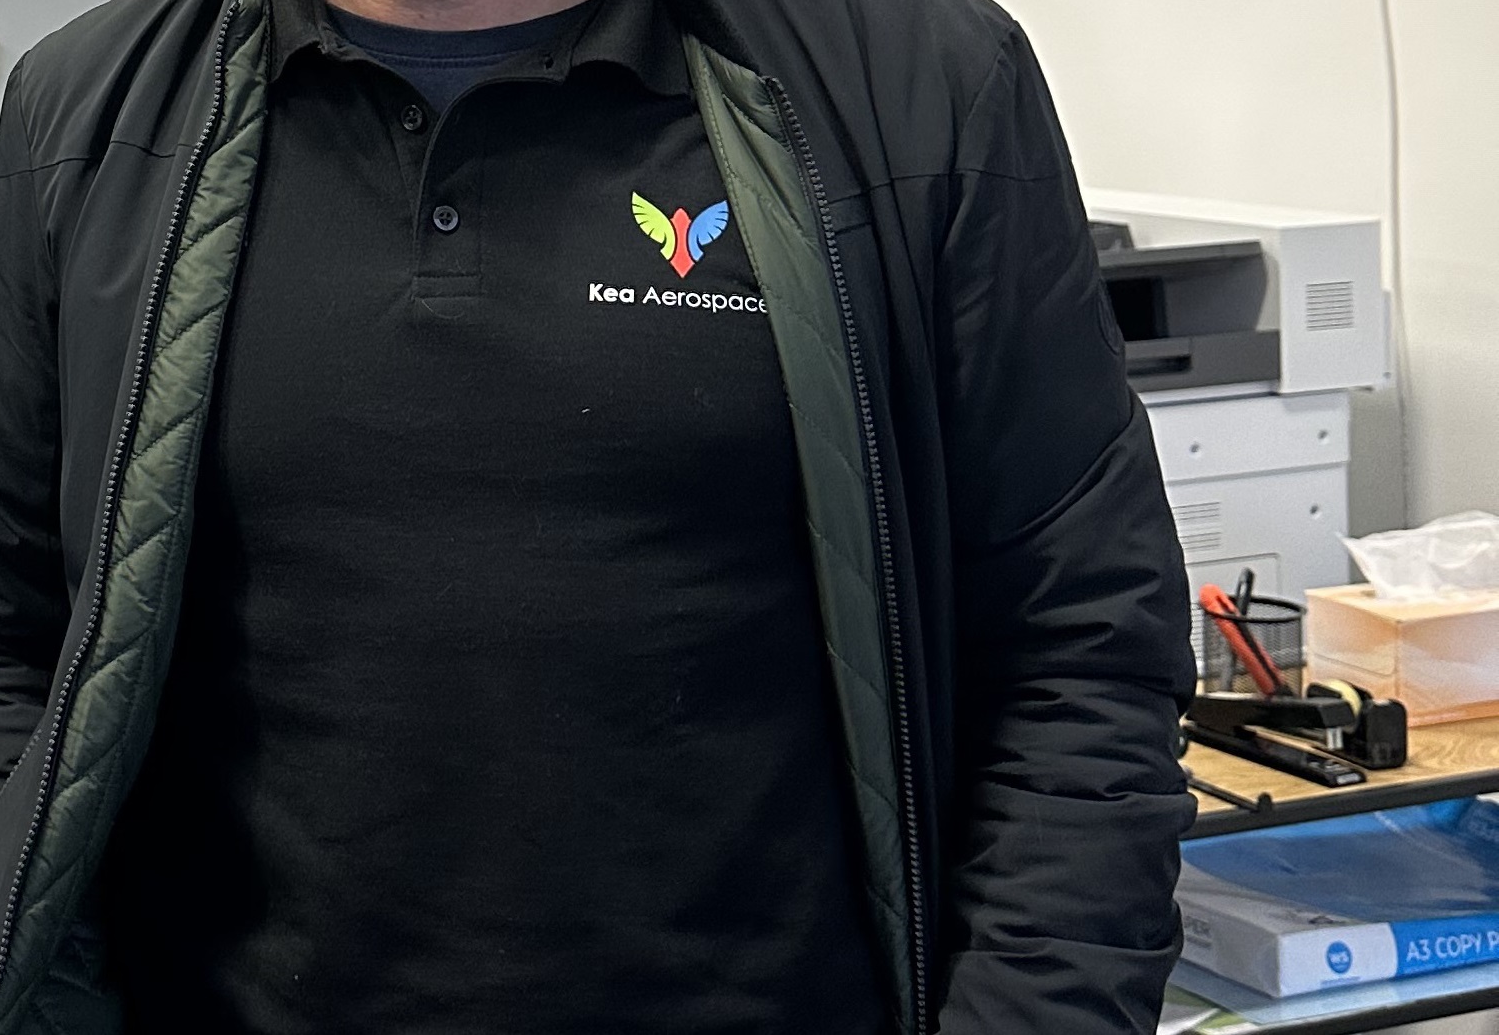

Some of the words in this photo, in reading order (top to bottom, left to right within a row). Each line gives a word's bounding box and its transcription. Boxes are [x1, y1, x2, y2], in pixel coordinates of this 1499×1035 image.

[588, 282, 636, 304] Kea
[1406, 939, 1432, 963] A3
[1435, 932, 1482, 959] COPY
[1487, 930, 1499, 952] P
